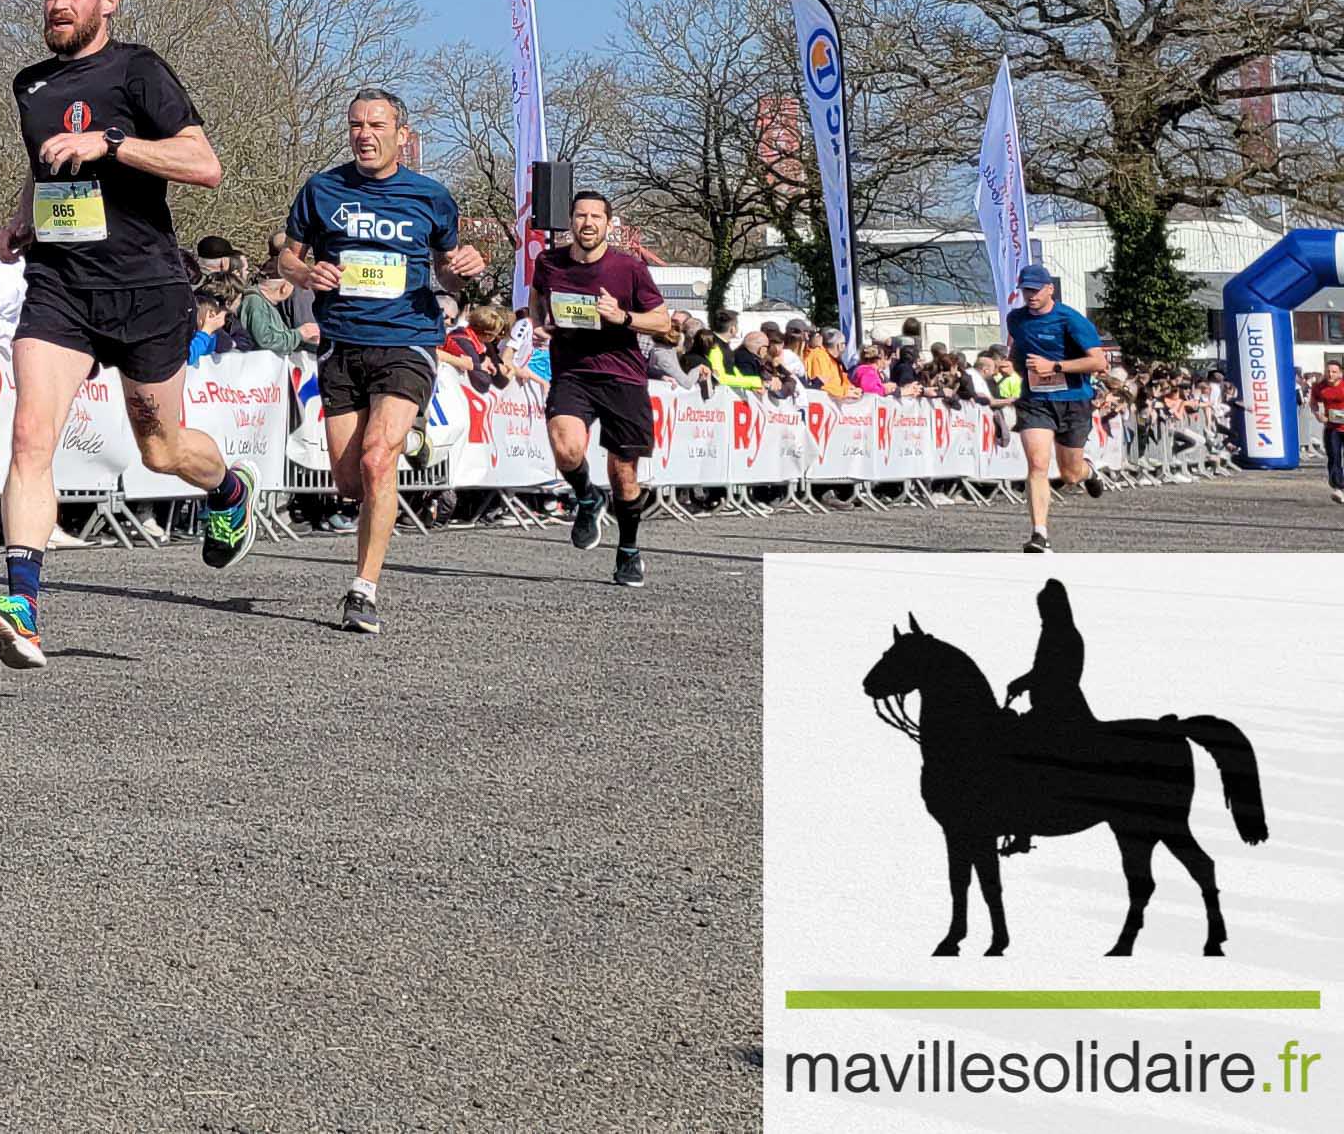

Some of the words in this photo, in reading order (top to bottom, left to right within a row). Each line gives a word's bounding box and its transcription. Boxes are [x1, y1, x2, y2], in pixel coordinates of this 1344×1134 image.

[52, 204, 75, 217] 865
[362, 268, 384, 279] 883
[566, 306, 583, 315] 930
[1247, 326, 1272, 430] INTERSPORT
[188, 387, 208, 403] La
